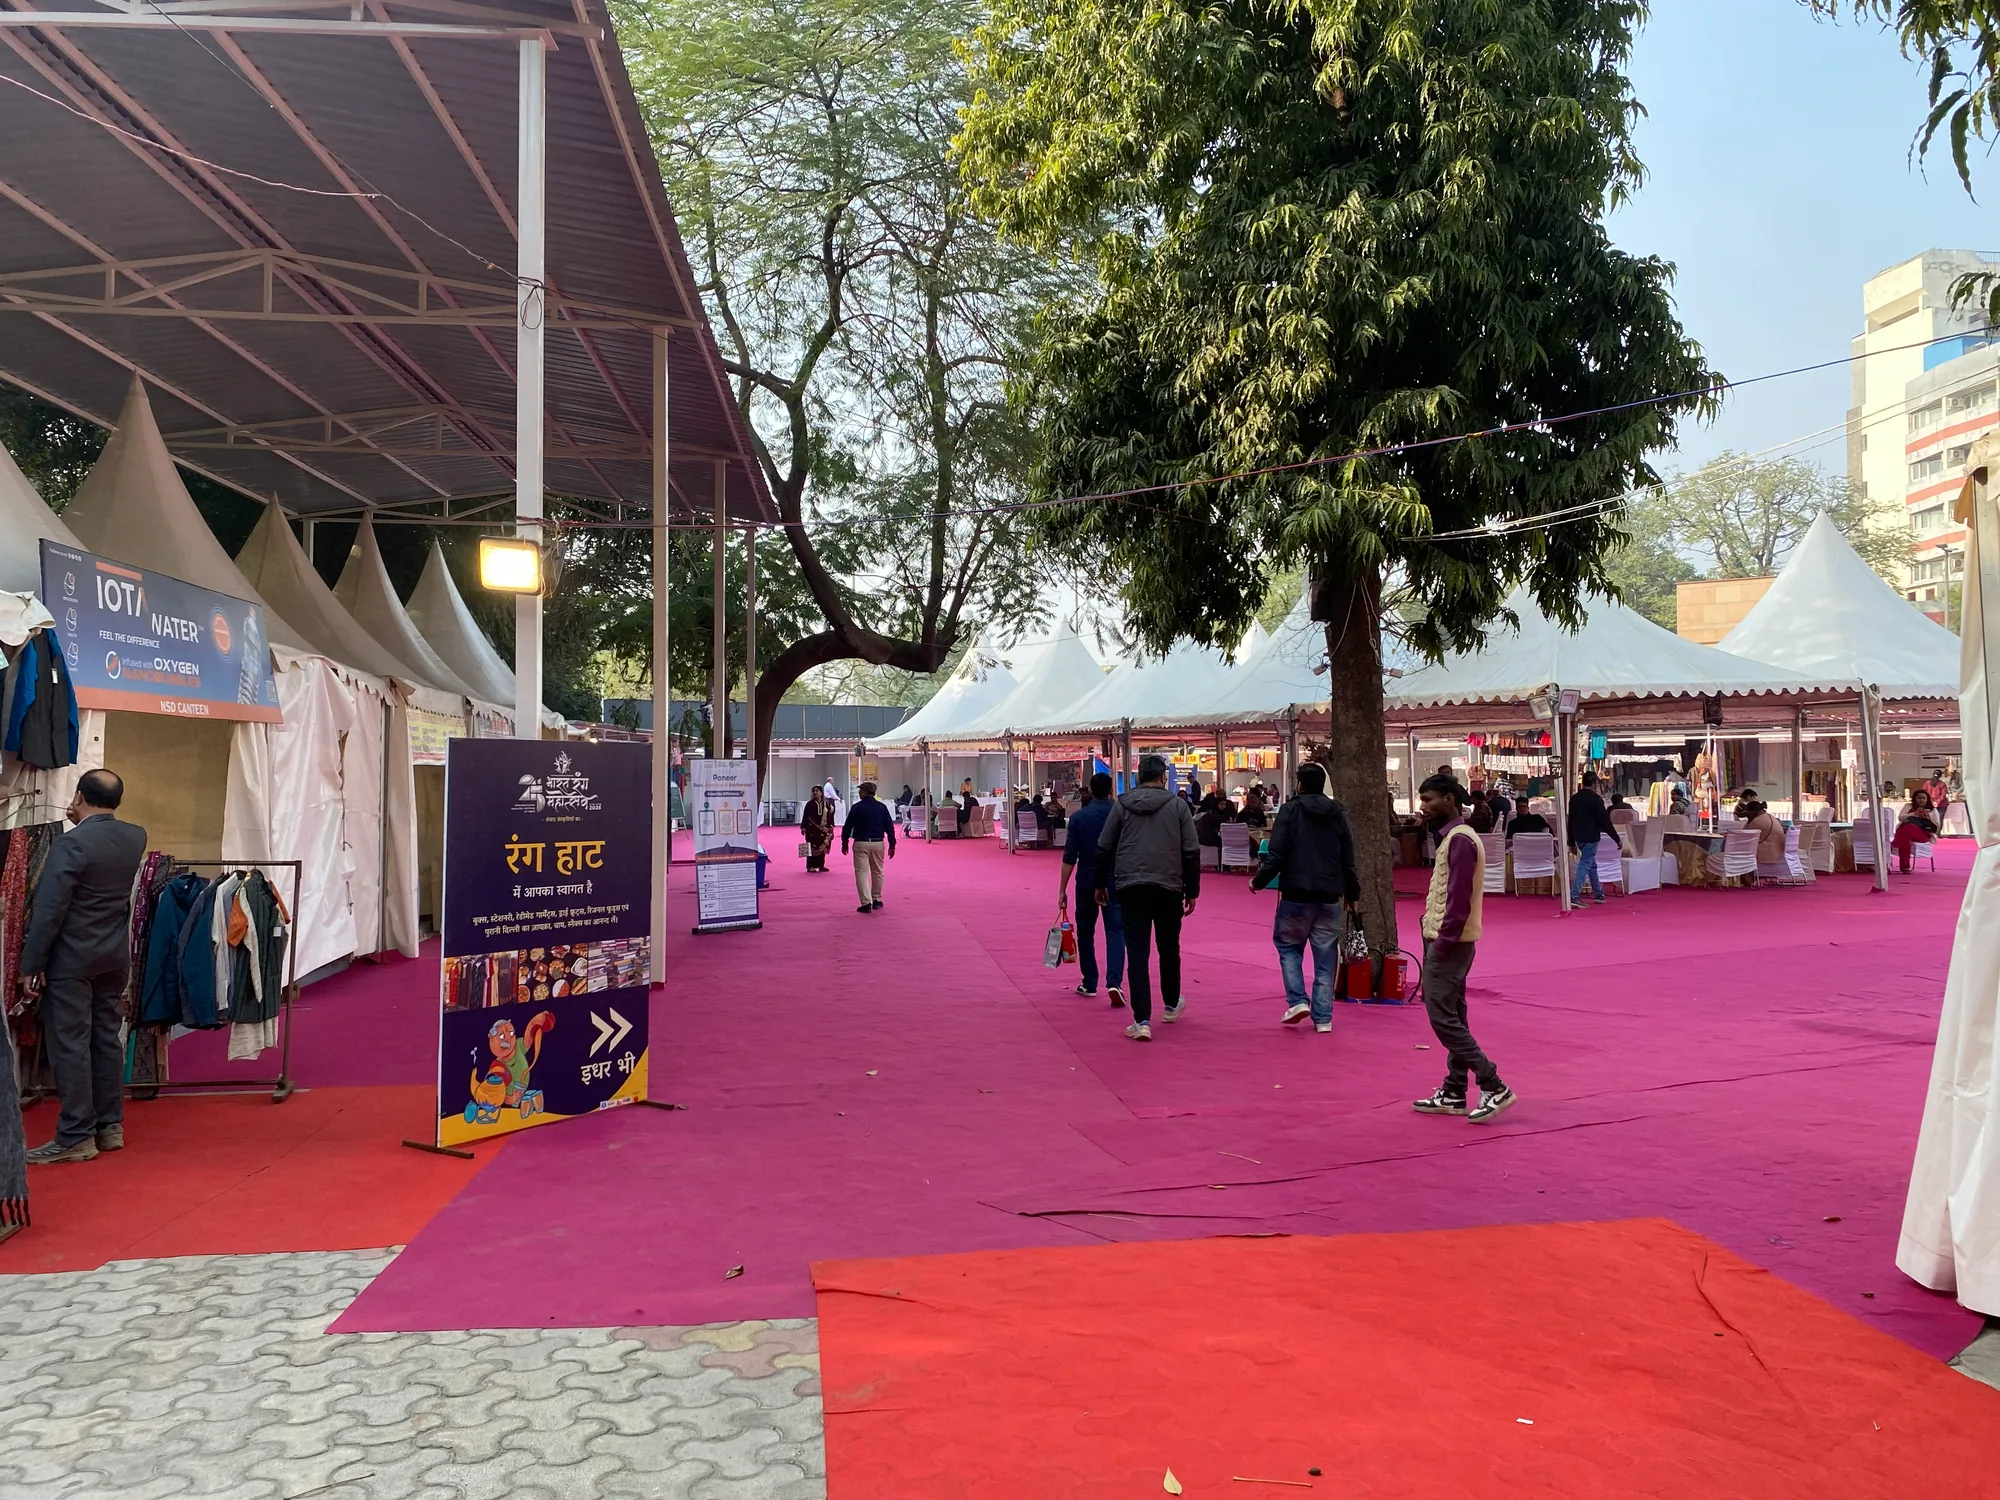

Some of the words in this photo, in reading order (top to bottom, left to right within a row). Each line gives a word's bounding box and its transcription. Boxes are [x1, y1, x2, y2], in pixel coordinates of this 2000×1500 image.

[97, 575, 148, 618] IOTA
[99, 630, 114, 640] FEEL
[115, 633, 126, 643] THE
[127, 635, 160, 649] DIFFERENCE
[142, 661, 153, 669] with
[154, 657, 199, 675] OXYGEN
[160, 701, 176, 712] NSD
[178, 702, 209, 715] CANTEEN
[571, 771, 590, 791] रंग
[1551, 767, 1562, 776] 54
[505, 833, 546, 874] रंग
[554, 840, 606, 875] हाट
[512, 885, 521, 898] में
[524, 886, 554, 897] आपका
[556, 884, 584, 895] स्वागत
[586, 879, 593, 894] है
[485, 925, 501, 937] पुरानी
[502, 924, 520, 934] दिल्ली
[580, 1060, 612, 1085] इधर
[617, 1051, 636, 1074] भी
